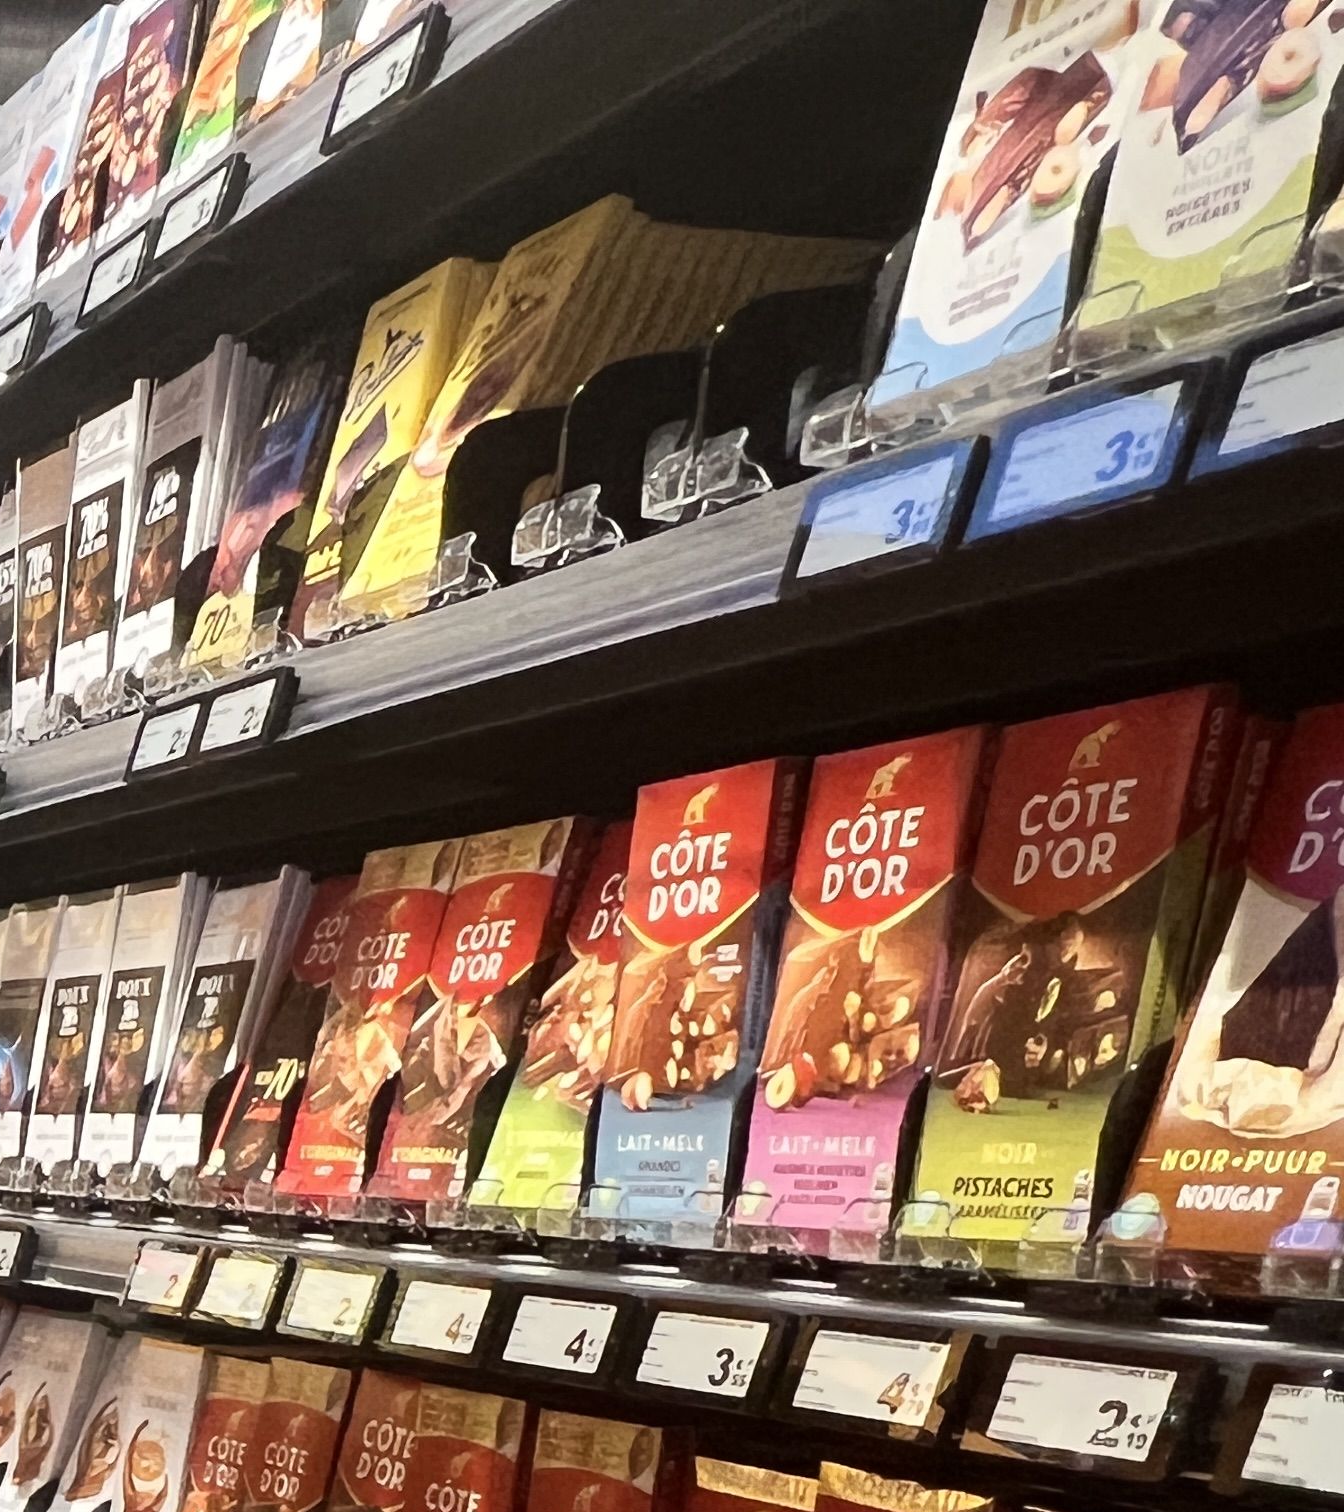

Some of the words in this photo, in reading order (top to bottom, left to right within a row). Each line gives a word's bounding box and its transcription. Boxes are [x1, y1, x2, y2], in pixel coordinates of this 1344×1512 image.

[1095, 431, 1135, 483] 3
[1019, 777, 1138, 838] CÔTE
[824, 804, 925, 862] CÔTE
[649, 828, 731, 882] CÔTE
[1013, 830, 1117, 886] D'OR
[820, 854, 910, 905] D'OR
[647, 876, 720, 922] D'OR
[357, 929, 411, 961] CÔTE
[456, 916, 517, 953] CÔTE
[351, 963, 399, 991] D'OR
[448, 952, 504, 985] D'OR
[769, 1136, 811, 1156] LAIT
[981, 1142, 1037, 1165] NOIR
[1160, 1149, 1230, 1174] NOIR
[1244, 1150, 1327, 1175] PUUR
[952, 1176, 1054, 1200] PISTACHES
[1176, 1184, 1284, 1213] NOUGAT
[163, 1275, 179, 1299] 2
[708, 1348, 734, 1386] 3
[362, 1416, 419, 1459] CÔTE
[1088, 1400, 1128, 1448] 2
[207, 1433, 249, 1467] CÔTE
[264, 1437, 310, 1474] CÔTE
[202, 1460, 240, 1490] D'OR
[260, 1468, 300, 1500] D'OR
[355, 1452, 407, 1492] D'OR
